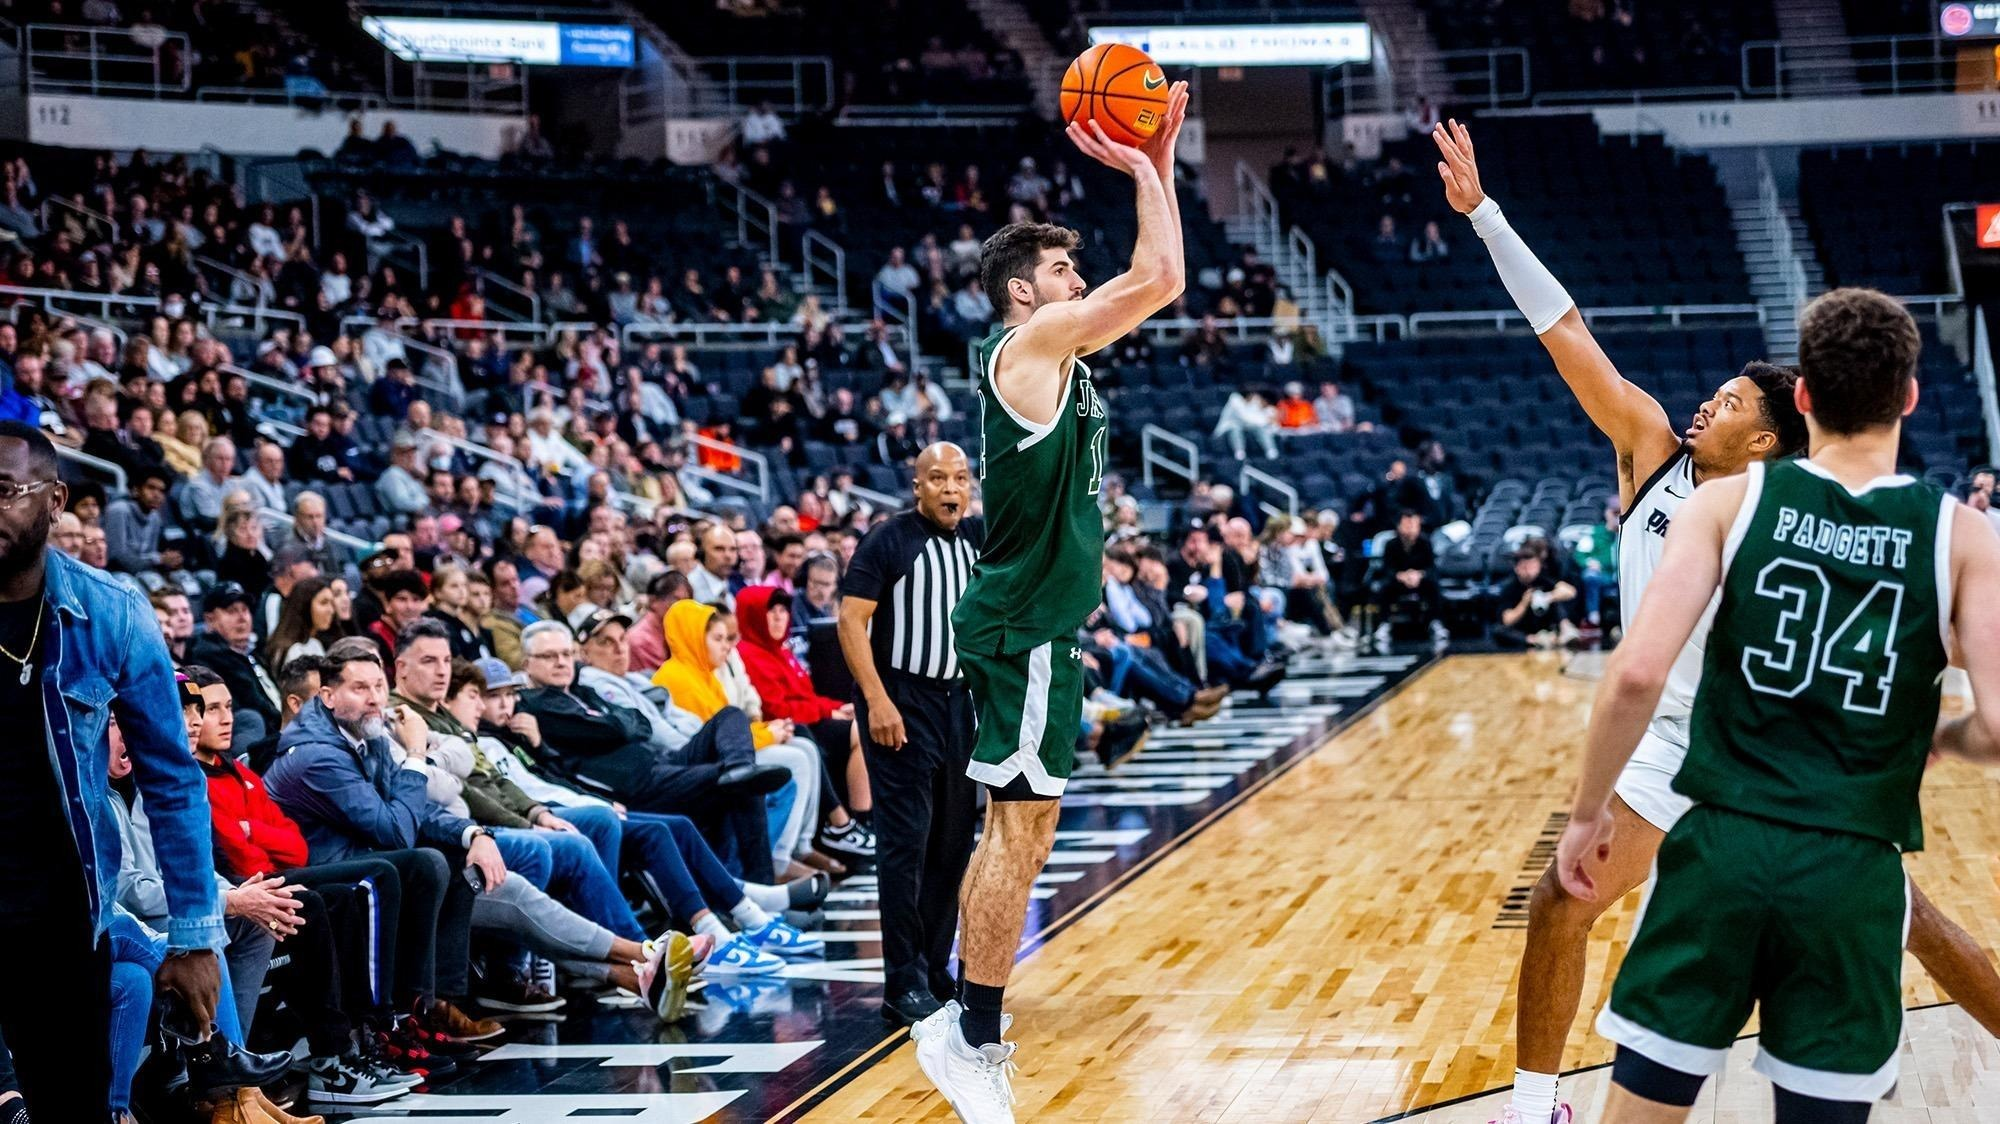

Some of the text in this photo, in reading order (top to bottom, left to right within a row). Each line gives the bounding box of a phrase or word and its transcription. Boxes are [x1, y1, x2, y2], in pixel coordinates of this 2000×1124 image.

[38, 104, 71, 126] 112
[1773, 506, 1913, 569] PADGETT
[1740, 556, 1905, 716] 34
